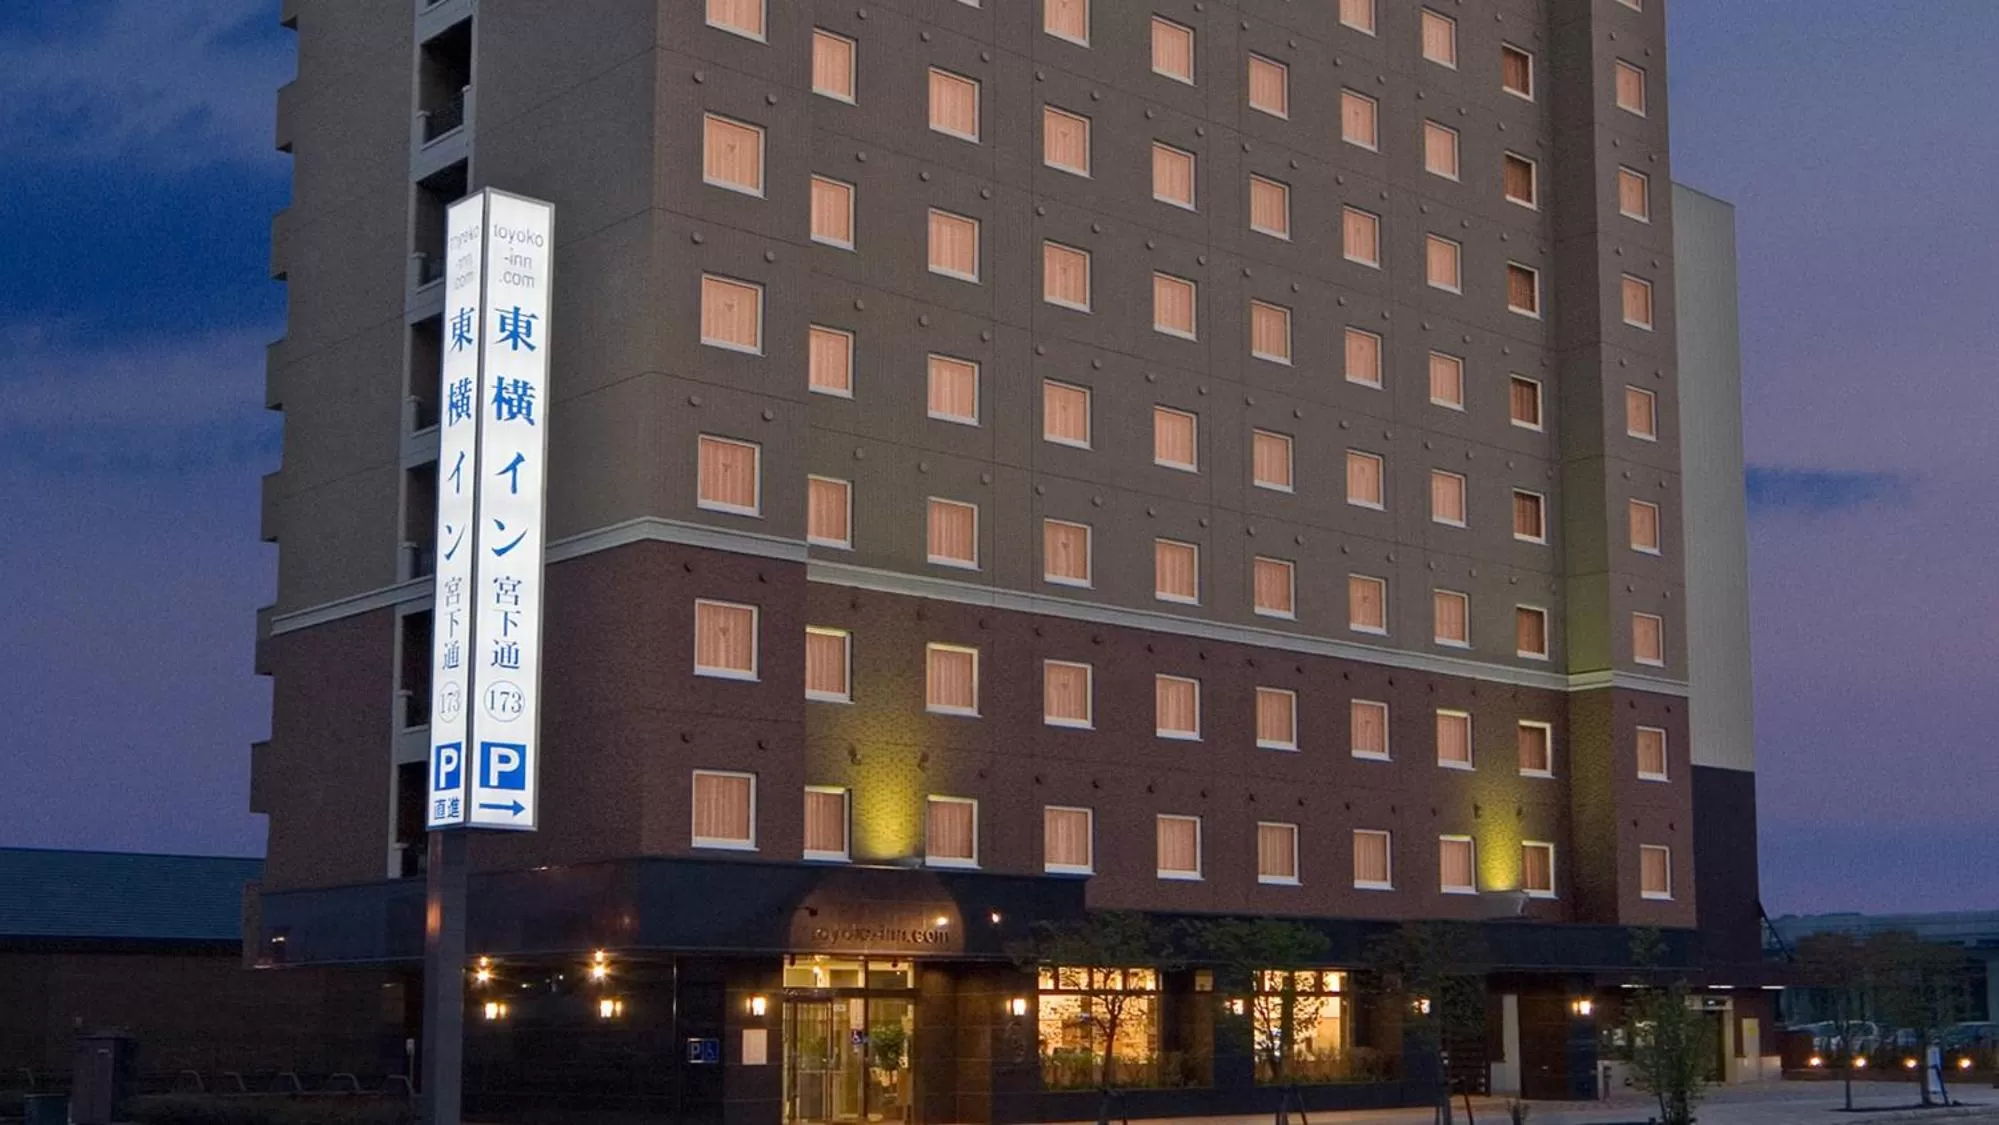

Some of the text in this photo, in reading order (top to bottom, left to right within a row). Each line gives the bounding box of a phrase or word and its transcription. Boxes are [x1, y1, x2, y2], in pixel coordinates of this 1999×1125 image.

[493, 224, 544, 248] toyoko
[504, 247, 533, 269] -inn
[500, 270, 535, 288] .com
[444, 307, 475, 560] 東横イン
[491, 306, 539, 556] 東横イン
[489, 690, 522, 714] 173
[439, 748, 458, 788] P
[489, 747, 520, 786] P
